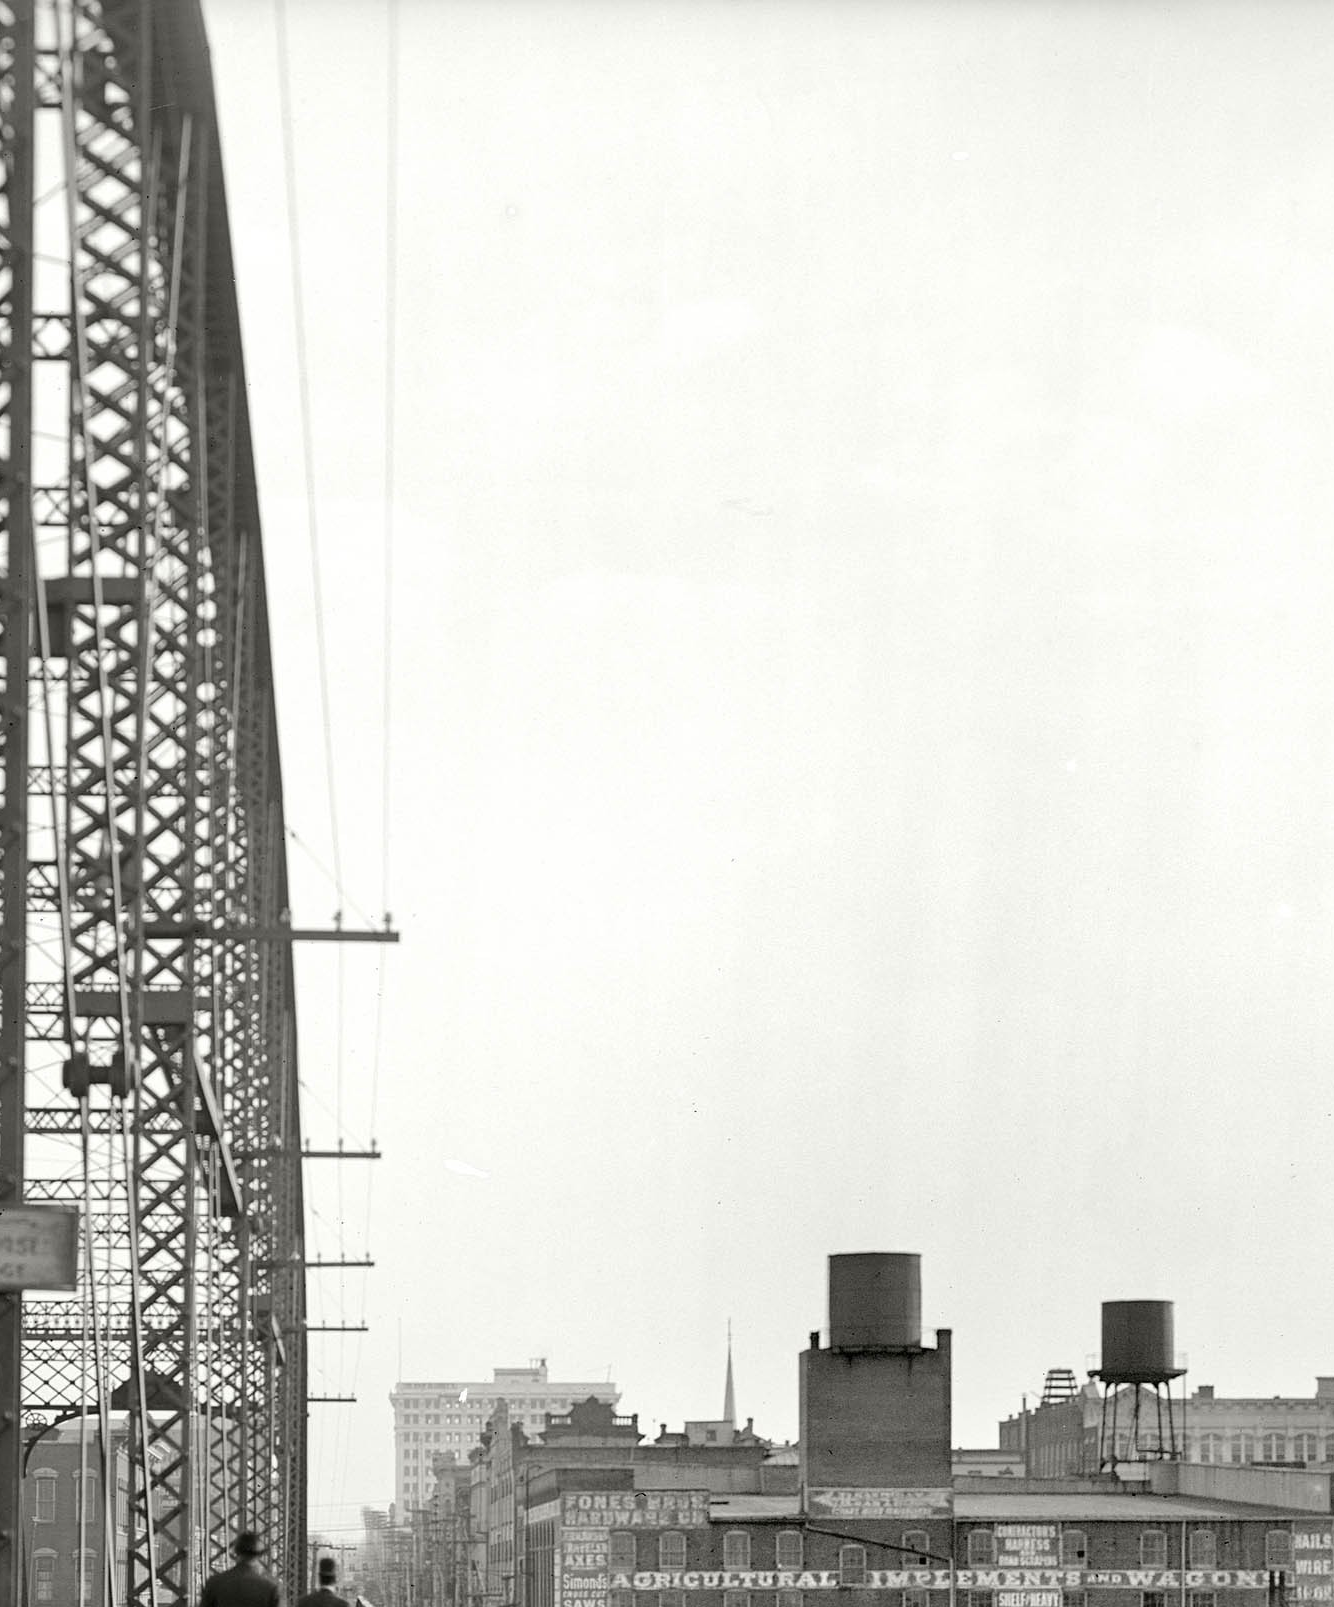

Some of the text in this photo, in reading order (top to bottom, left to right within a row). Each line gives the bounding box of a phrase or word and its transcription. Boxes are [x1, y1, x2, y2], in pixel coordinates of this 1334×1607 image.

[566, 1495, 635, 1510] FONES
[612, 1572, 837, 1588] AGRICULTURAL
[871, 1572, 1081, 1588] IMPLEMENTS
[1087, 1574, 1122, 1584] AND
